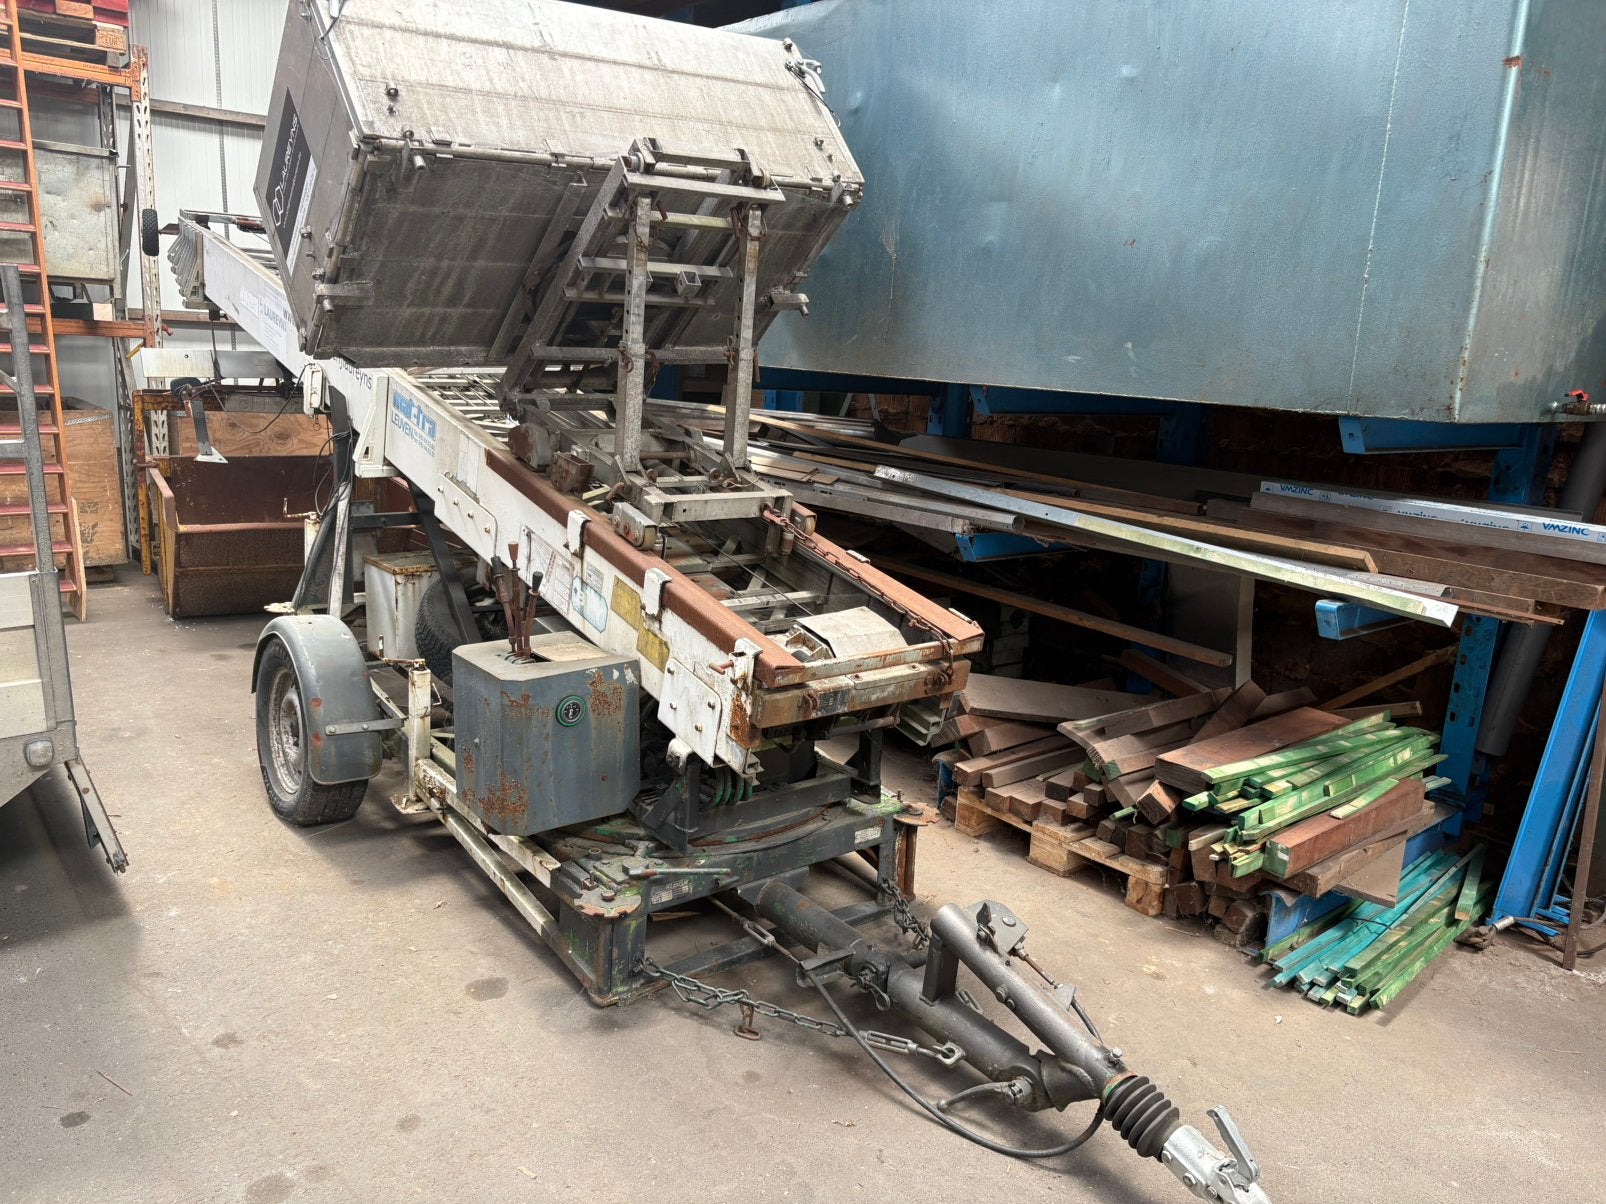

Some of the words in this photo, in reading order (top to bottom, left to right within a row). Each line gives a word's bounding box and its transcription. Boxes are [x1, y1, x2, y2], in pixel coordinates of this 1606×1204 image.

[279, 113, 298, 189] LAUREYNS
[391, 410, 414, 440] LEUVEN
[1280, 484, 1314, 496] VMZINC
[1541, 521, 1590, 537] VMZINC
